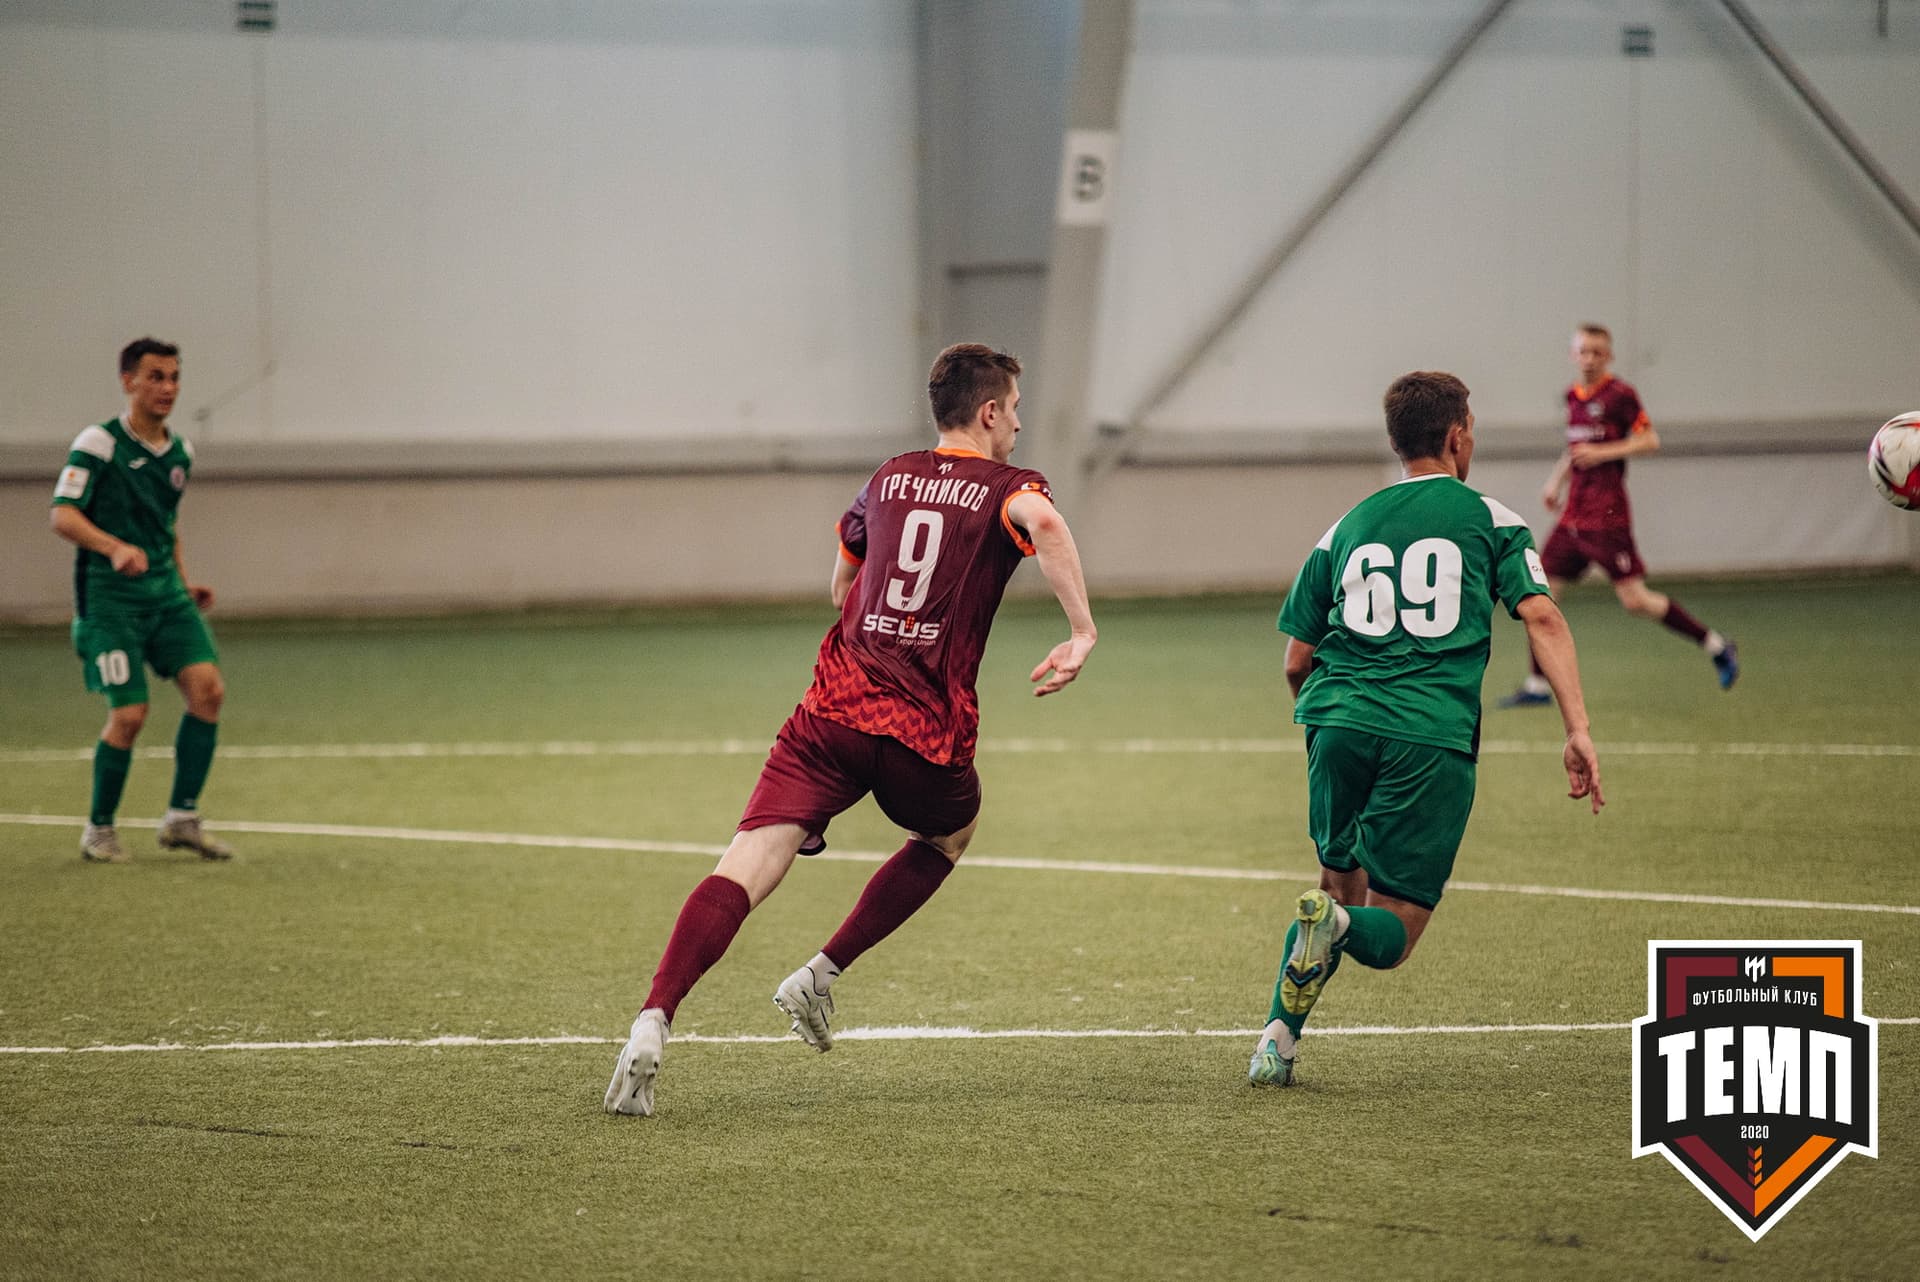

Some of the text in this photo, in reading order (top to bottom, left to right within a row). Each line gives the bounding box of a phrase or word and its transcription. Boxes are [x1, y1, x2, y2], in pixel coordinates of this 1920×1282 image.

[880, 473, 989, 512] ГРЕЧНИКОВ
[886, 509, 944, 612] 9
[1341, 537, 1463, 638] 69
[96, 649, 130, 687] 10
